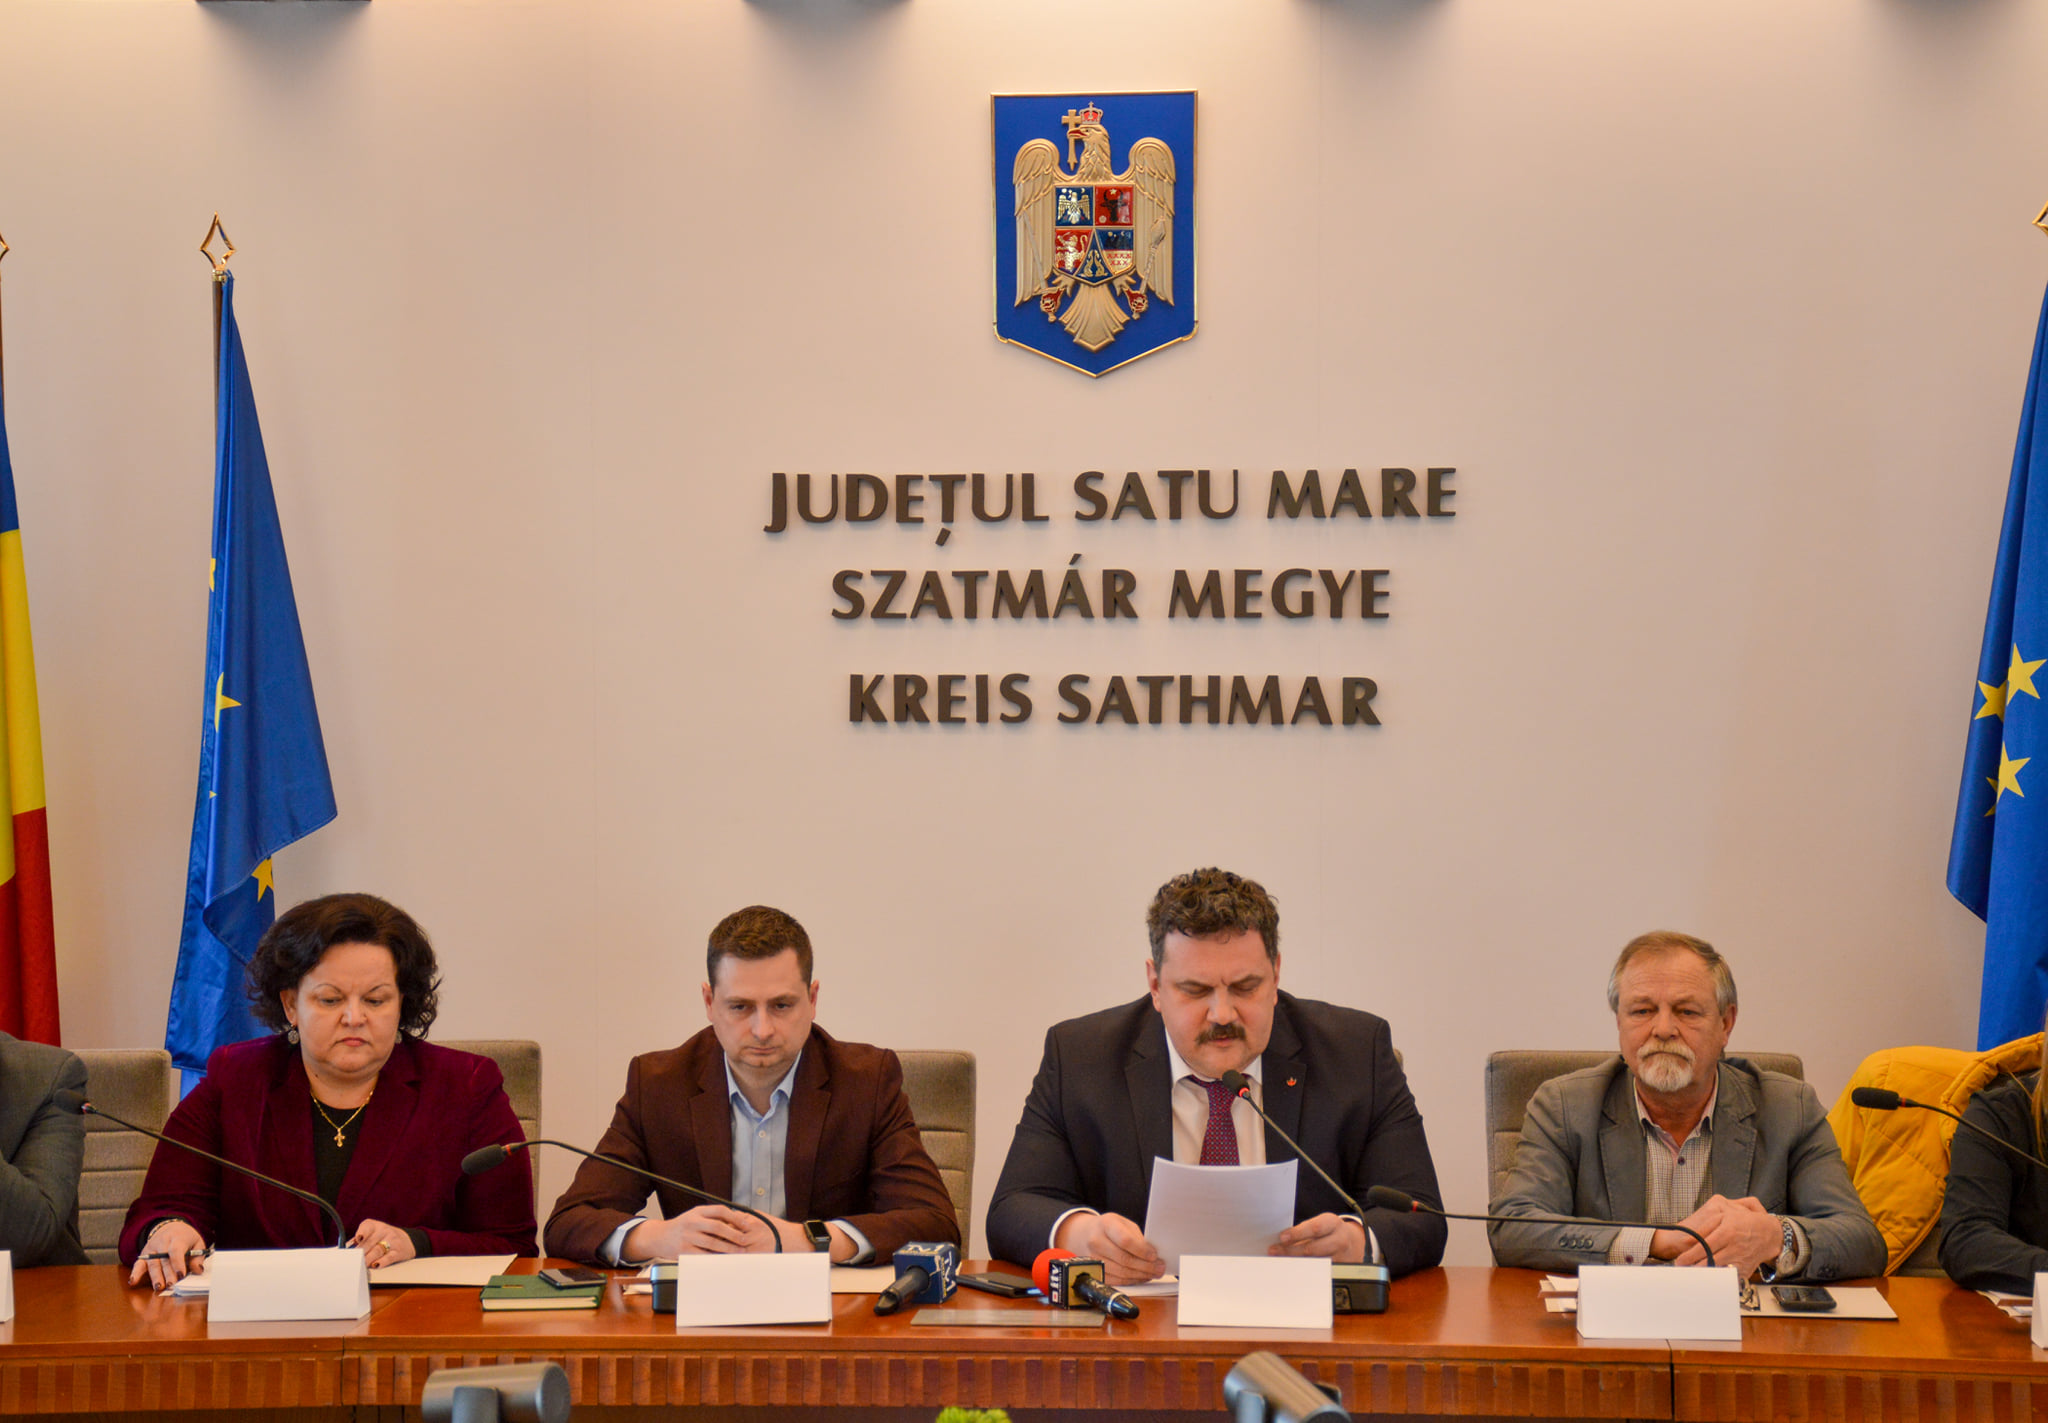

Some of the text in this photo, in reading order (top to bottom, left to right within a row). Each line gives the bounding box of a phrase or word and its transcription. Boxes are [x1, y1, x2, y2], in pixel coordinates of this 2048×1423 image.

[1074, 470, 1239, 522] SATU
[1266, 467, 1457, 520] MARE
[832, 553, 1390, 621] SZATMÁR MEGYE
[849, 673, 1382, 727] KREIS SATHMAR
